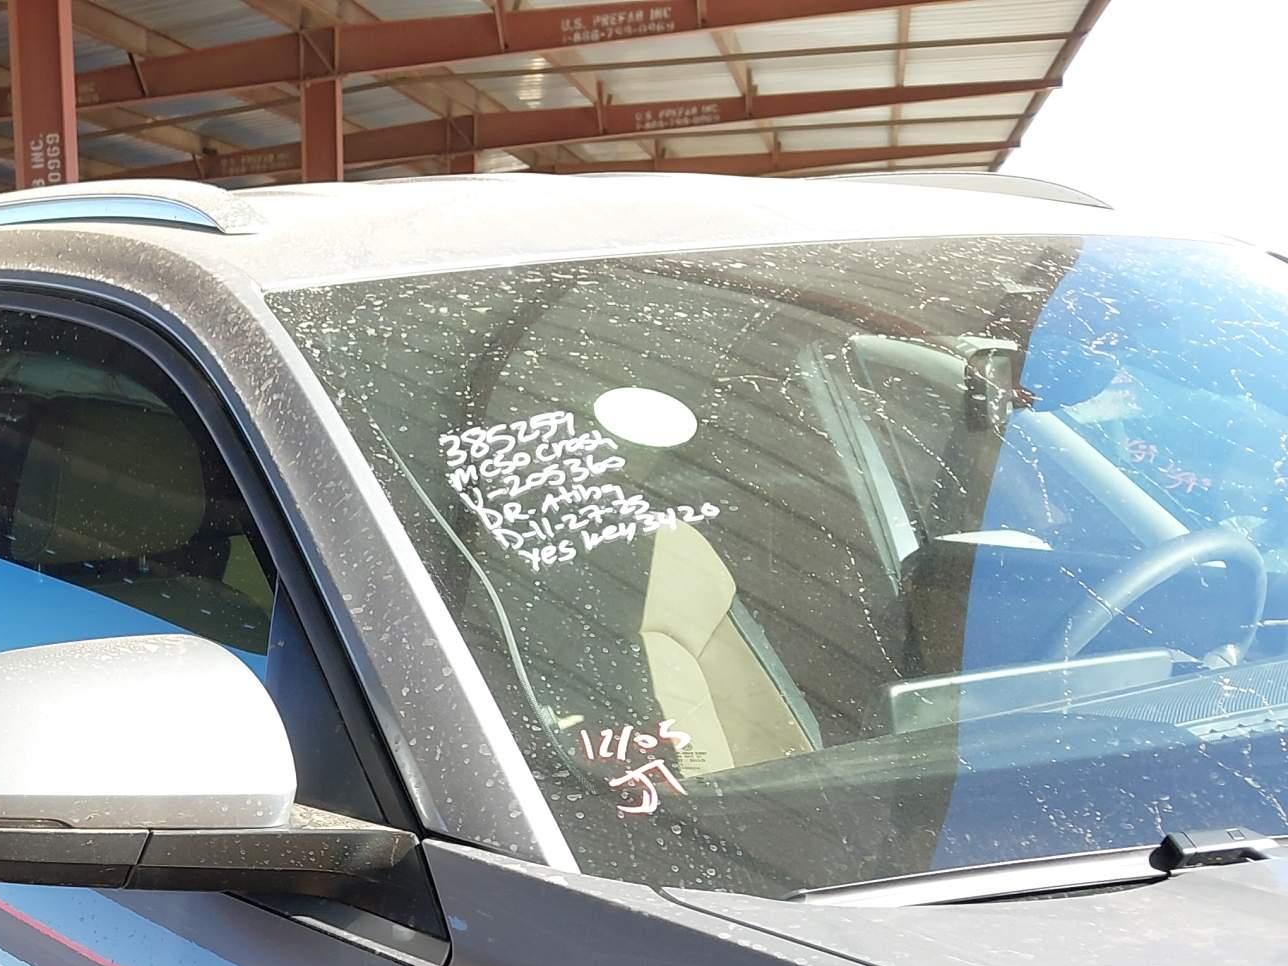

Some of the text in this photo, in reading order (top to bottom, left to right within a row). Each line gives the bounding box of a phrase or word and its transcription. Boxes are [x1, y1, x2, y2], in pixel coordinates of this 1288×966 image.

[46, 132, 62, 183] 0969
[439, 410, 575, 467] 385259
[580, 718, 692, 761] 12/05
